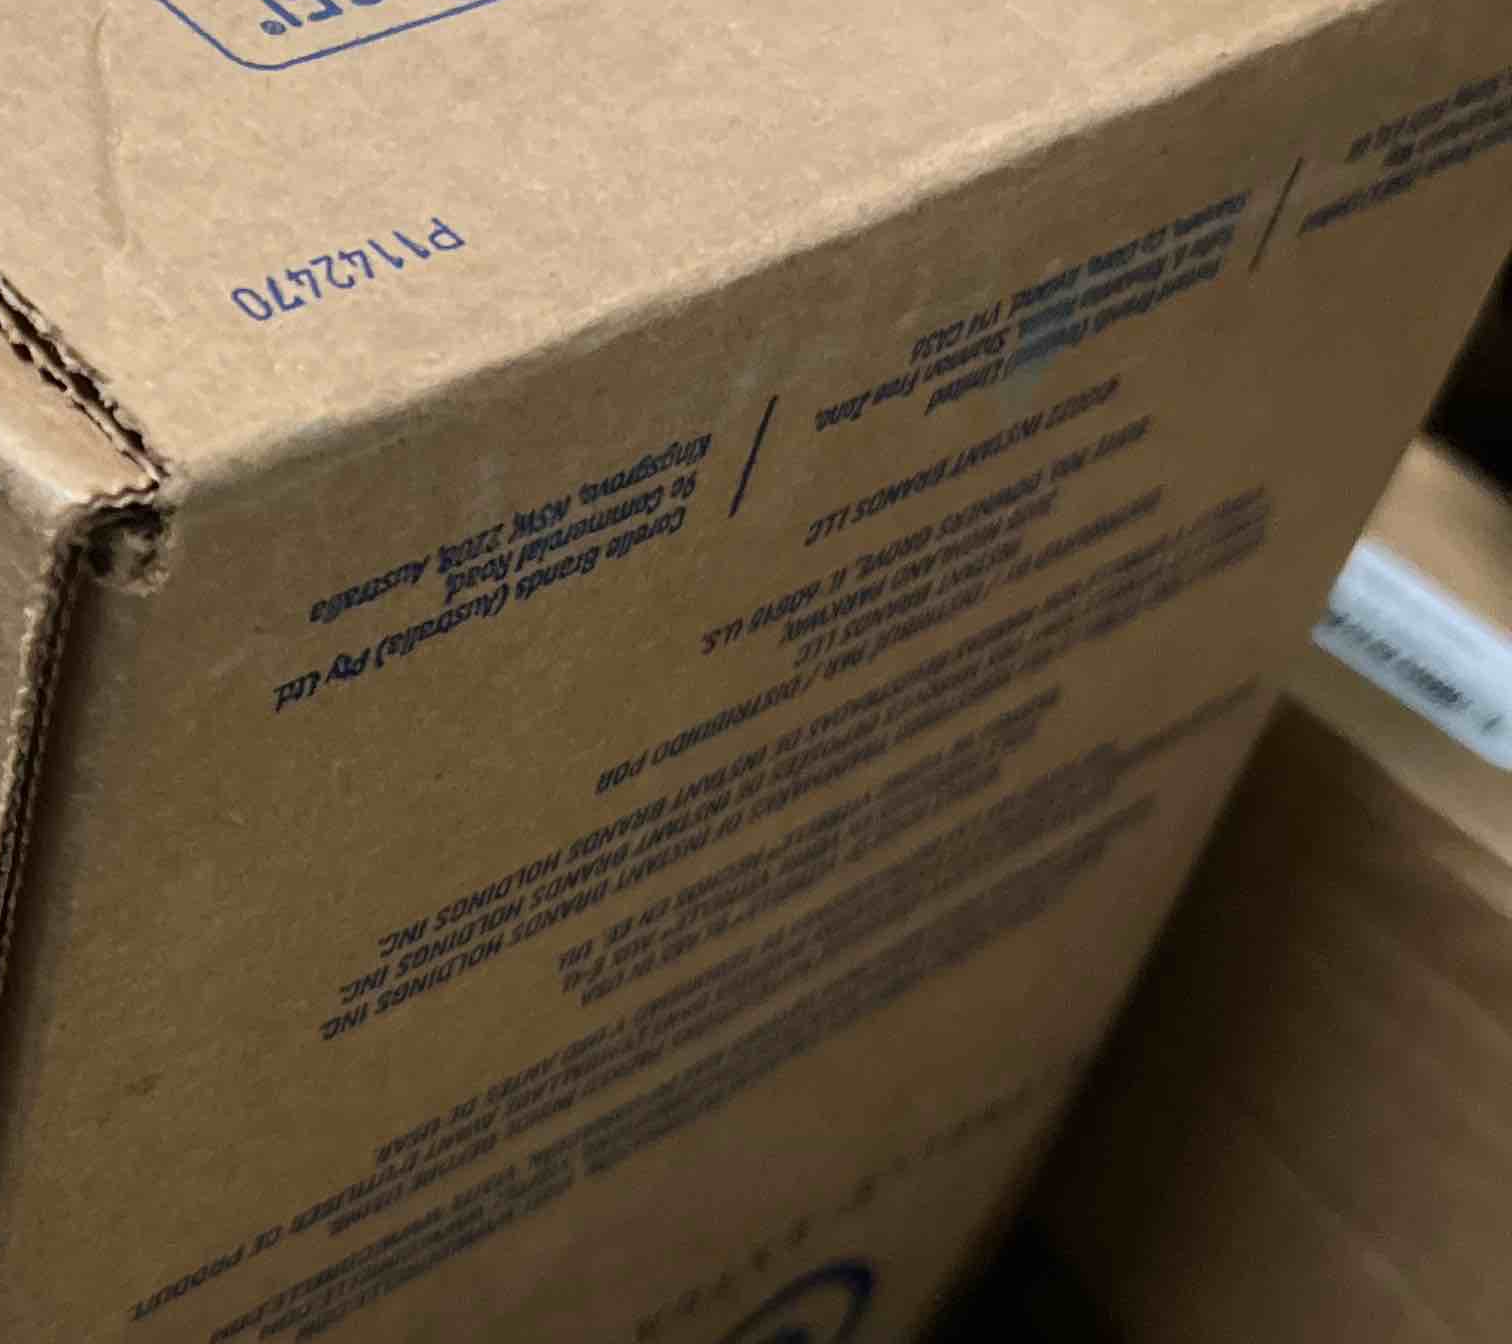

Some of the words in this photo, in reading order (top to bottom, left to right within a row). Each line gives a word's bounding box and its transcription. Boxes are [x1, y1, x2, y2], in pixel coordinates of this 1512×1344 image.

[229, 216, 466, 322] P1142470
[875, 368, 919, 403] Free
[927, 360, 1001, 408] Limited
[953, 415, 1042, 472] INSTANT
[853, 459, 948, 520] BRANDS
[518, 481, 666, 566] Commercial
[607, 503, 686, 558] Corelle
[514, 542, 600, 600] Brands
[376, 585, 508, 664] (Australia)
[841, 583, 931, 640] BRANDS
[673, 744, 767, 804] INSTANT
[568, 796, 666, 858] BRANDS
[636, 790, 729, 850] INSTANT
[532, 842, 629, 904] BRANDS
[615, 825, 710, 887] INSTANT
[436, 850, 560, 926] HOLDINGS
[510, 879, 608, 942] BRANDS
[395, 896, 524, 975] HOLDINGS
[376, 934, 501, 1013] HOLDINGS
